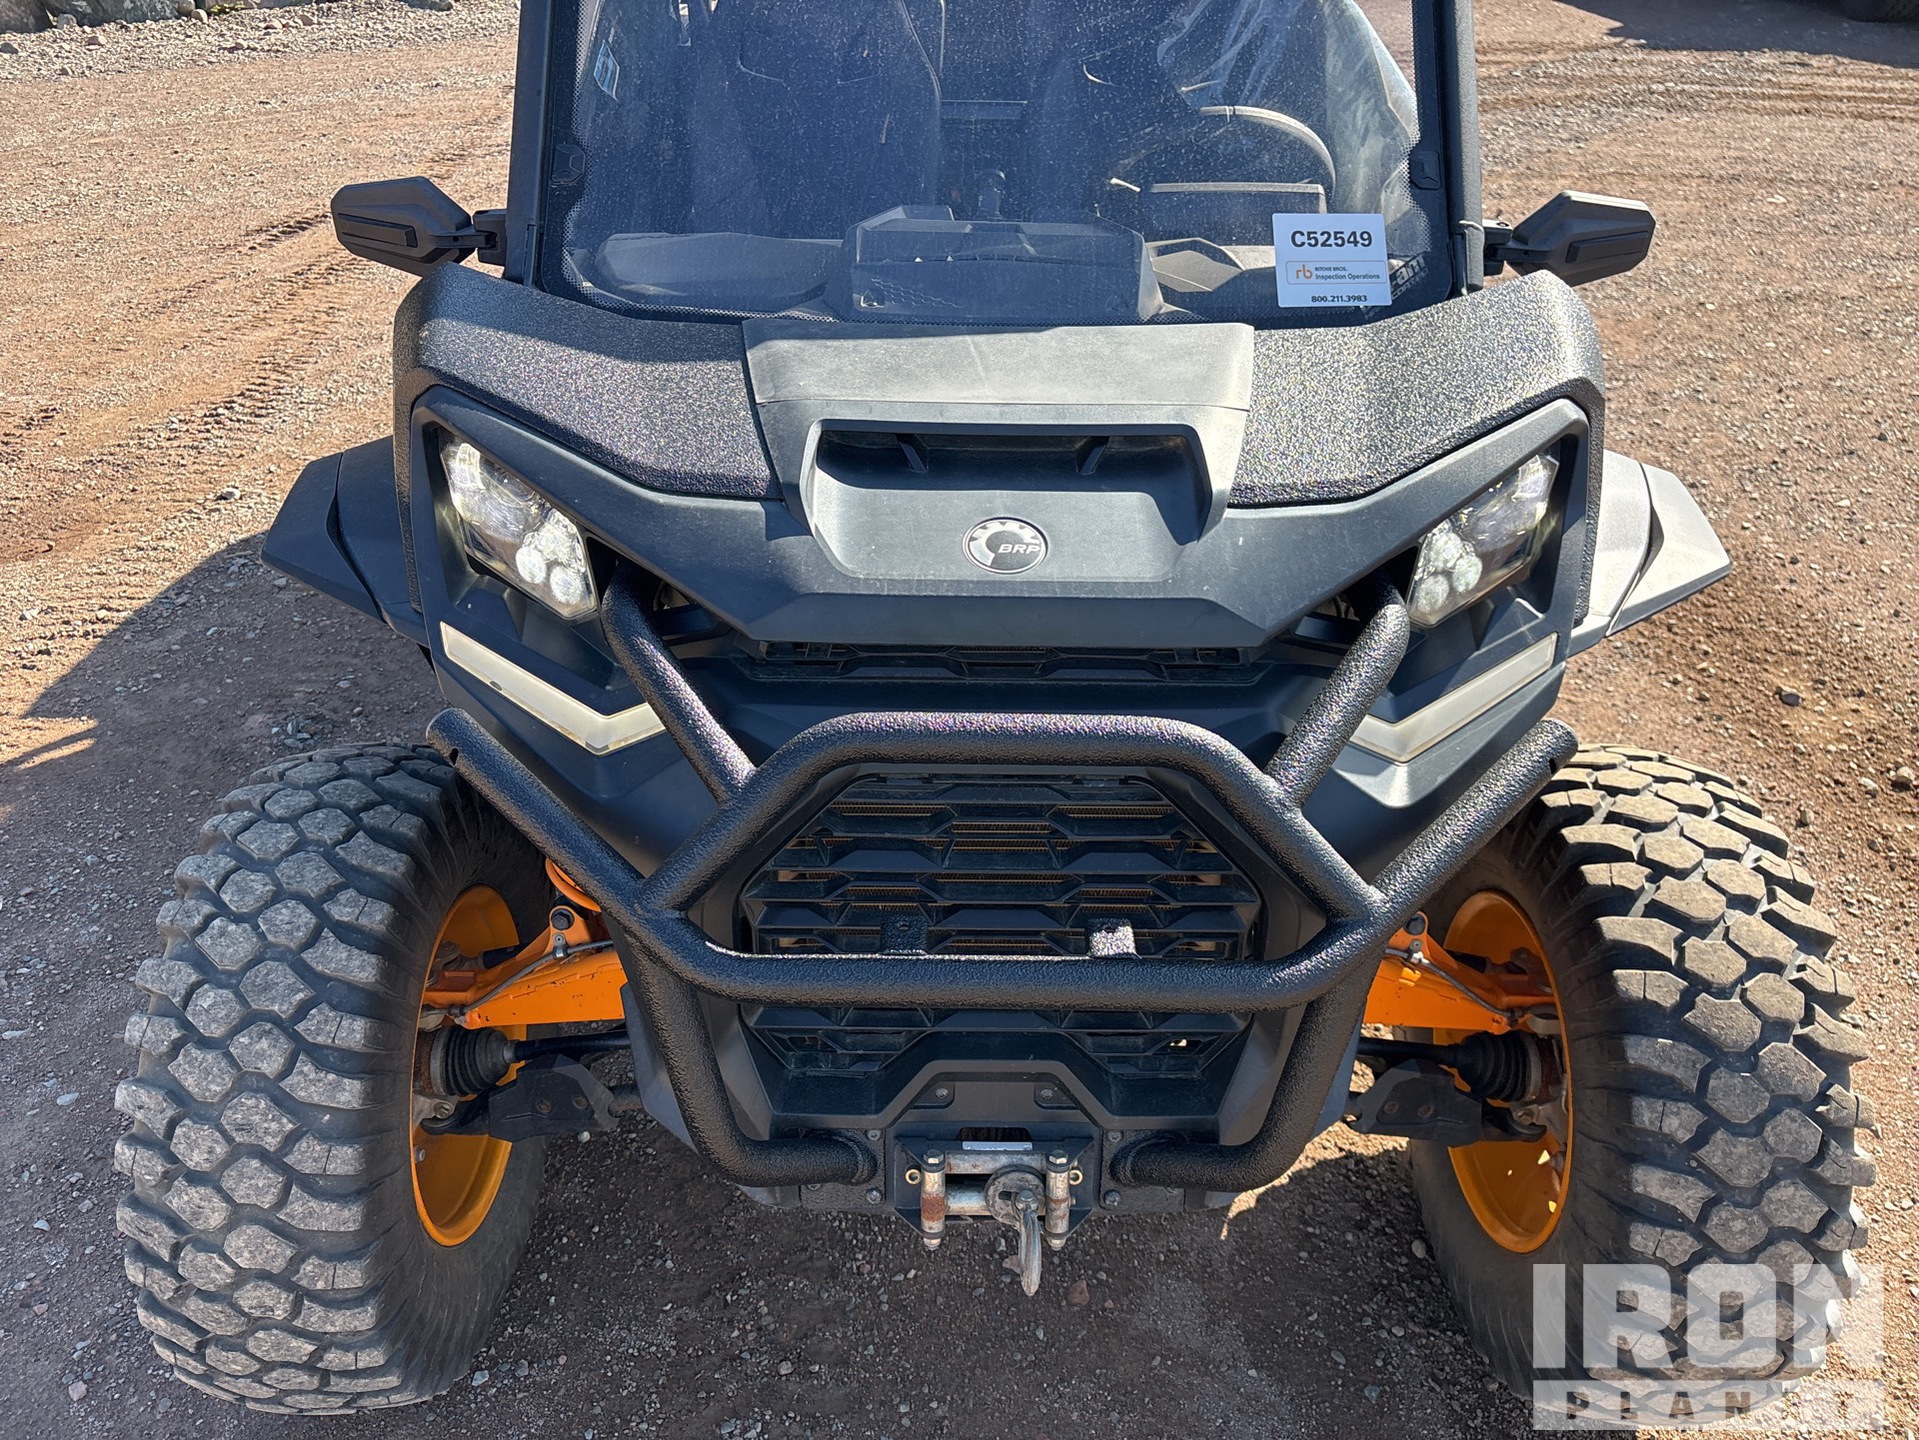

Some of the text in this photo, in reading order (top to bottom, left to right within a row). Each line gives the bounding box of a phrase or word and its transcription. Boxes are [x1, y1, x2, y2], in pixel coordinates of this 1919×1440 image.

[1291, 229, 1372, 247] C52549
[1315, 273, 1380, 281] Inspection Operations
[1311, 295, 1368, 303] 800.211.3983
[998, 543, 1040, 554] BRP
